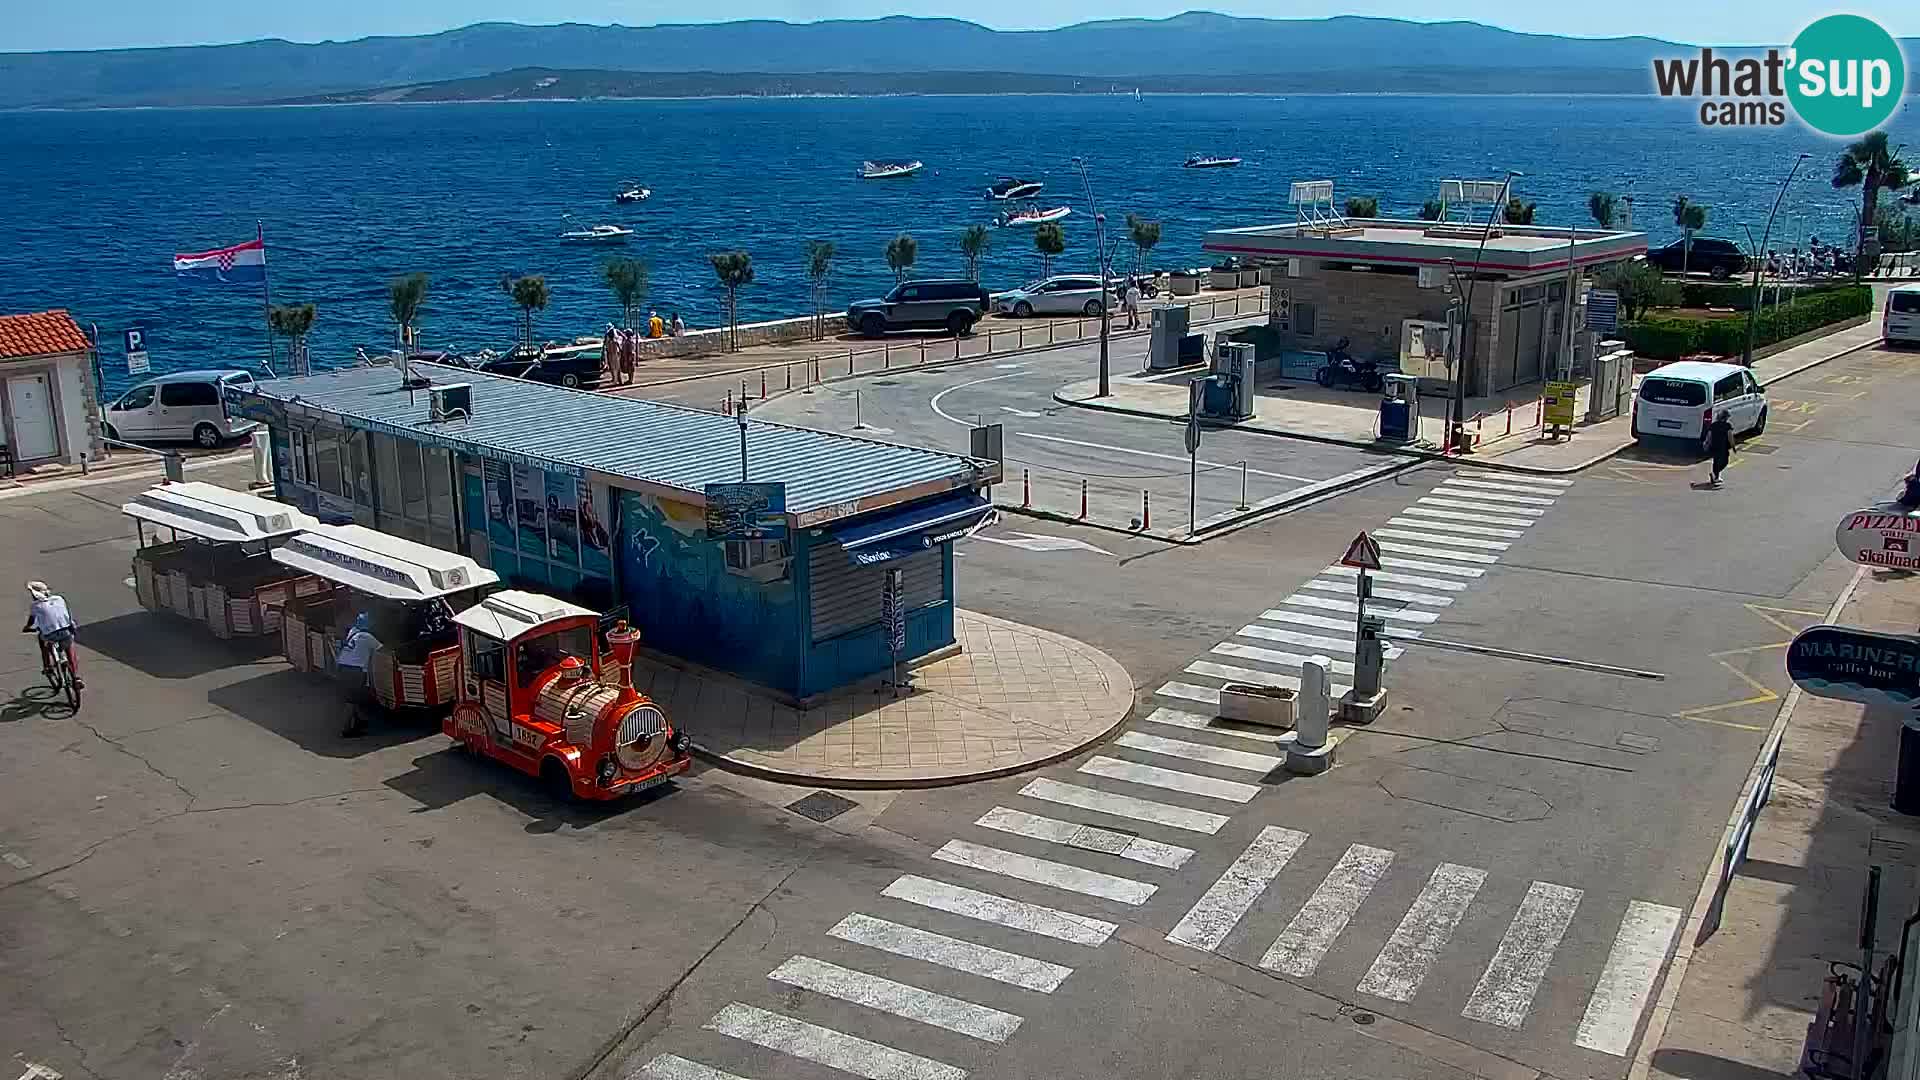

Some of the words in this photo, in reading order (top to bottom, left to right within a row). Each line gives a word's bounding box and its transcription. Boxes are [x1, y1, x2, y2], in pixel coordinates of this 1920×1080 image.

[128, 331, 141, 350] P
[493, 450, 528, 465] STATION
[528, 456, 553, 472] TICKET
[554, 463, 581, 477] OFFICE
[1847, 515, 1920, 533] PIZZE
[1868, 664, 1896, 680] bar
